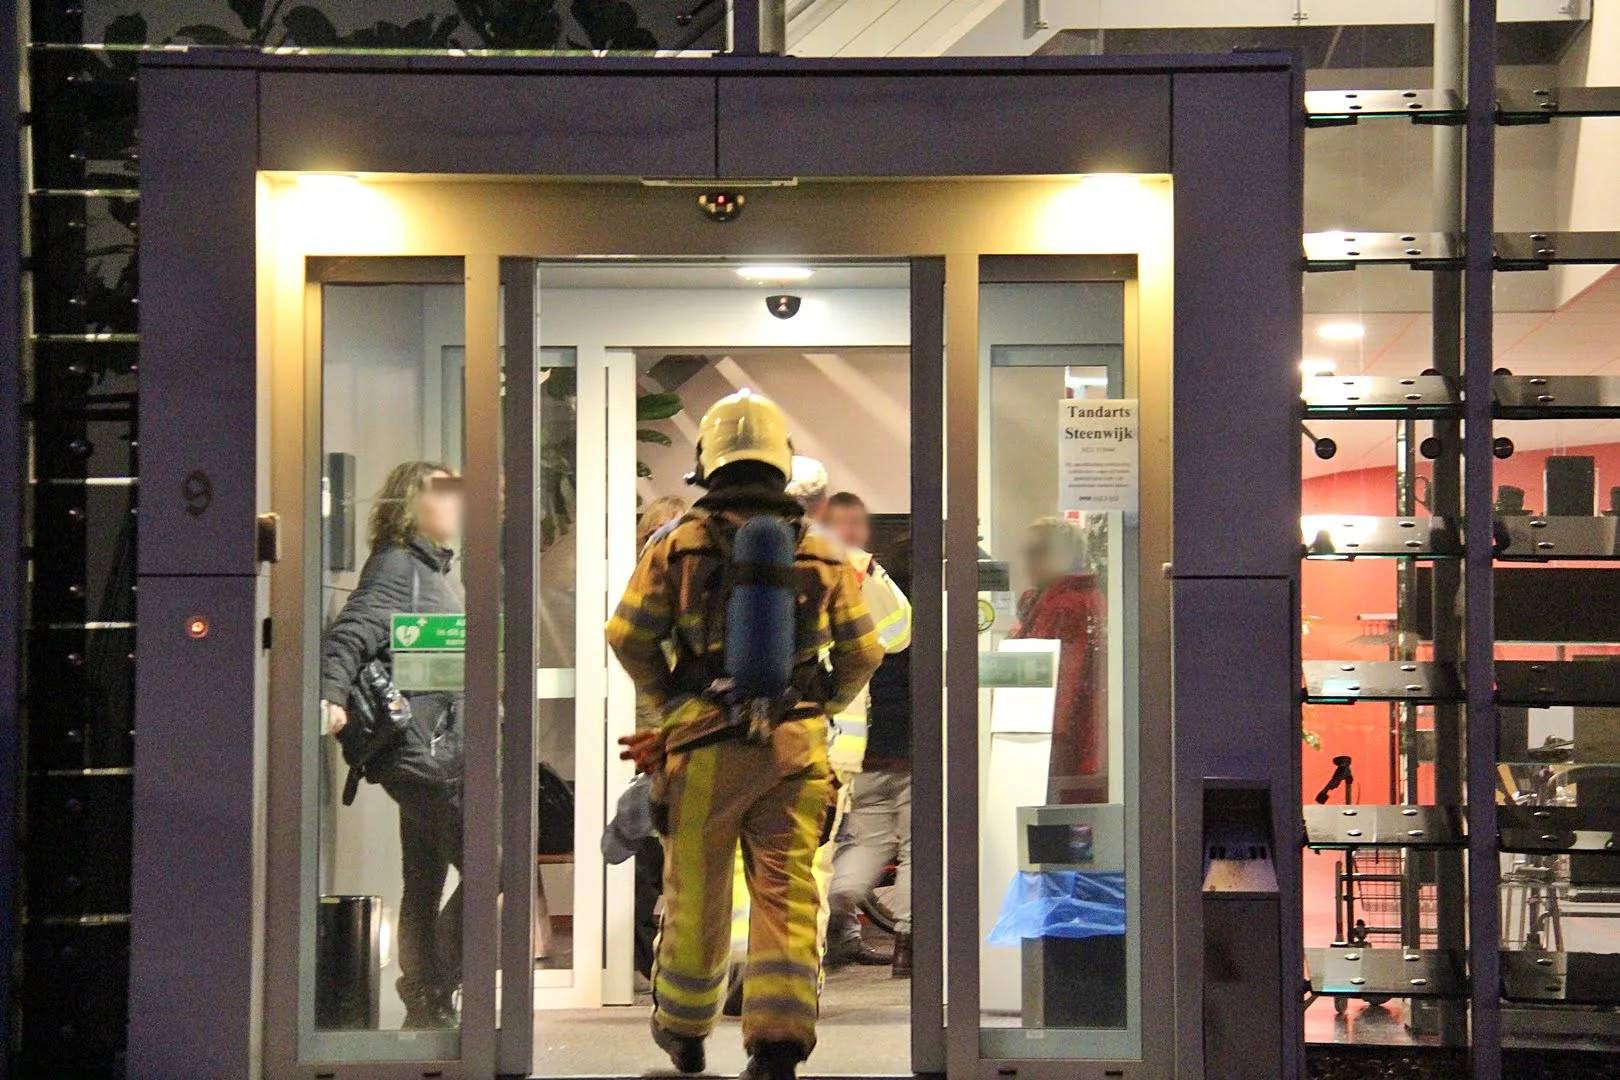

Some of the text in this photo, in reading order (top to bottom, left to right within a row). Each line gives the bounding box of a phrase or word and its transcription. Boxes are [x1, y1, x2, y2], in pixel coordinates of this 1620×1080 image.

[1067, 405, 1131, 418] Tandarts
[1064, 427, 1133, 442] Steenwijk
[182, 470, 212, 516] 9
